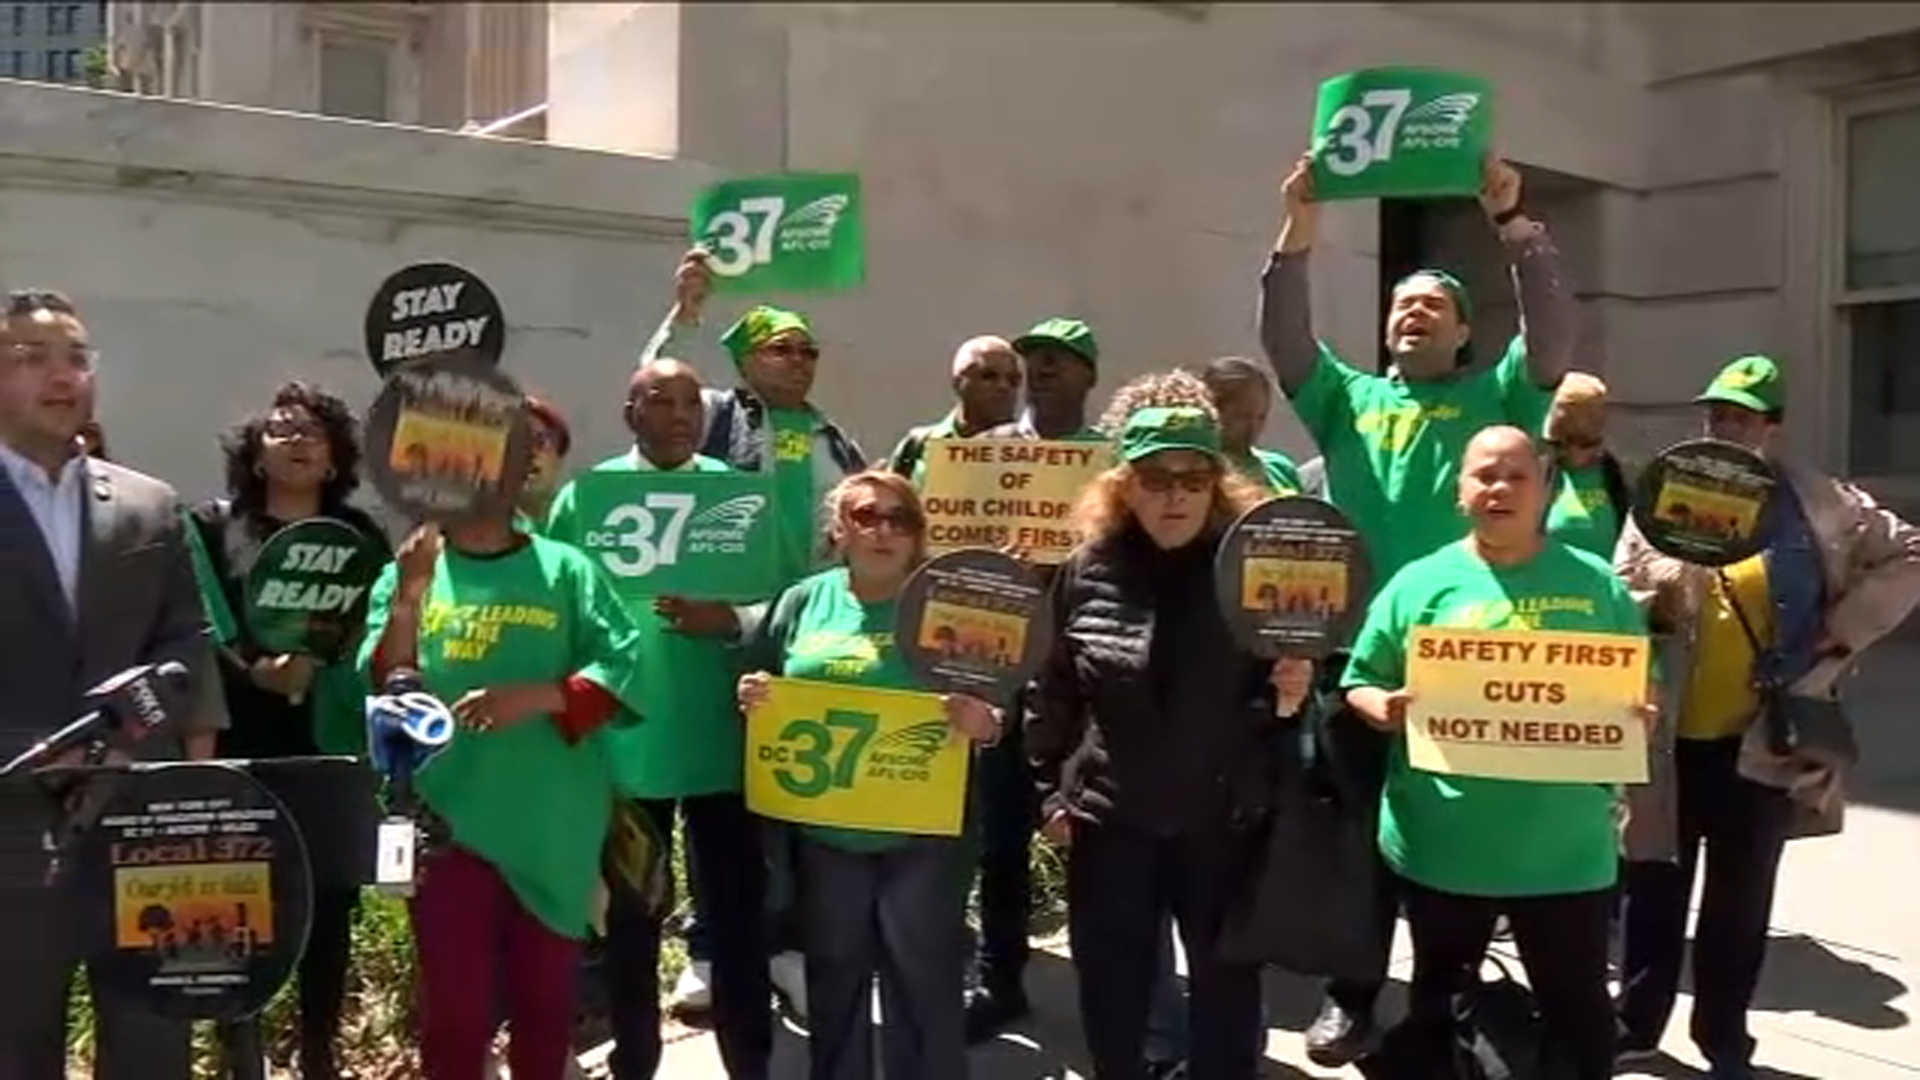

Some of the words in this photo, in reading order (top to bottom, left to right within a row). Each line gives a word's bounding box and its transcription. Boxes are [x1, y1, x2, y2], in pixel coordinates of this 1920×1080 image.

[1324, 89, 1412, 176] 37
[704, 197, 785, 276] 37
[392, 282, 465, 320] STAY
[383, 316, 489, 361] READY
[947, 445, 994, 463] THE
[1000, 446, 1093, 466] SAFETY
[1000, 472, 1033, 490] OF
[926, 498, 976, 517] OUR
[585, 531, 615, 547] DC
[602, 493, 695, 577] 37
[280, 543, 358, 574] STAY
[257, 579, 365, 614] READY
[1418, 638, 1537, 663] SAFETY
[1546, 644, 1637, 668] FIRST
[1484, 681, 1566, 704] CUTS
[1427, 717, 1489, 739] NOT
[1501, 721, 1624, 745] NEEDED
[759, 745, 789, 762] DC
[773, 709, 880, 798] 37
[111, 837, 209, 865] Local
